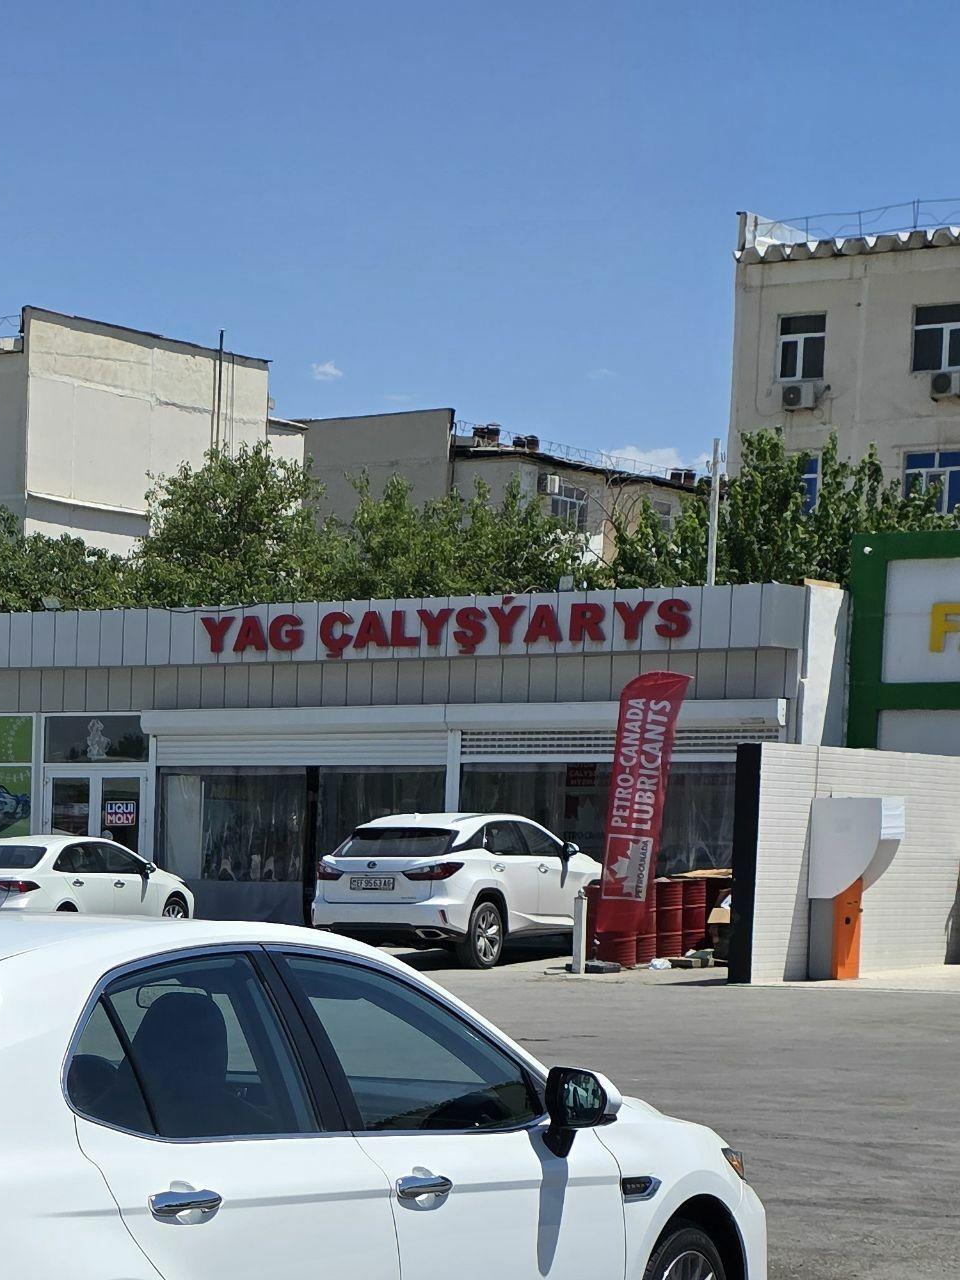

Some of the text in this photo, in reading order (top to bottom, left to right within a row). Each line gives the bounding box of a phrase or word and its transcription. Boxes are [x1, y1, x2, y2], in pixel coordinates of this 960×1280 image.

[200, 596, 692, 659] YAG ÇALYŞÝARYS
[611, 698, 647, 828] PETRO-CANADA
[632, 699, 672, 831] LUBRICANTS
[107, 803, 134, 813] LIQUI
[107, 813, 134, 824] MOLY
